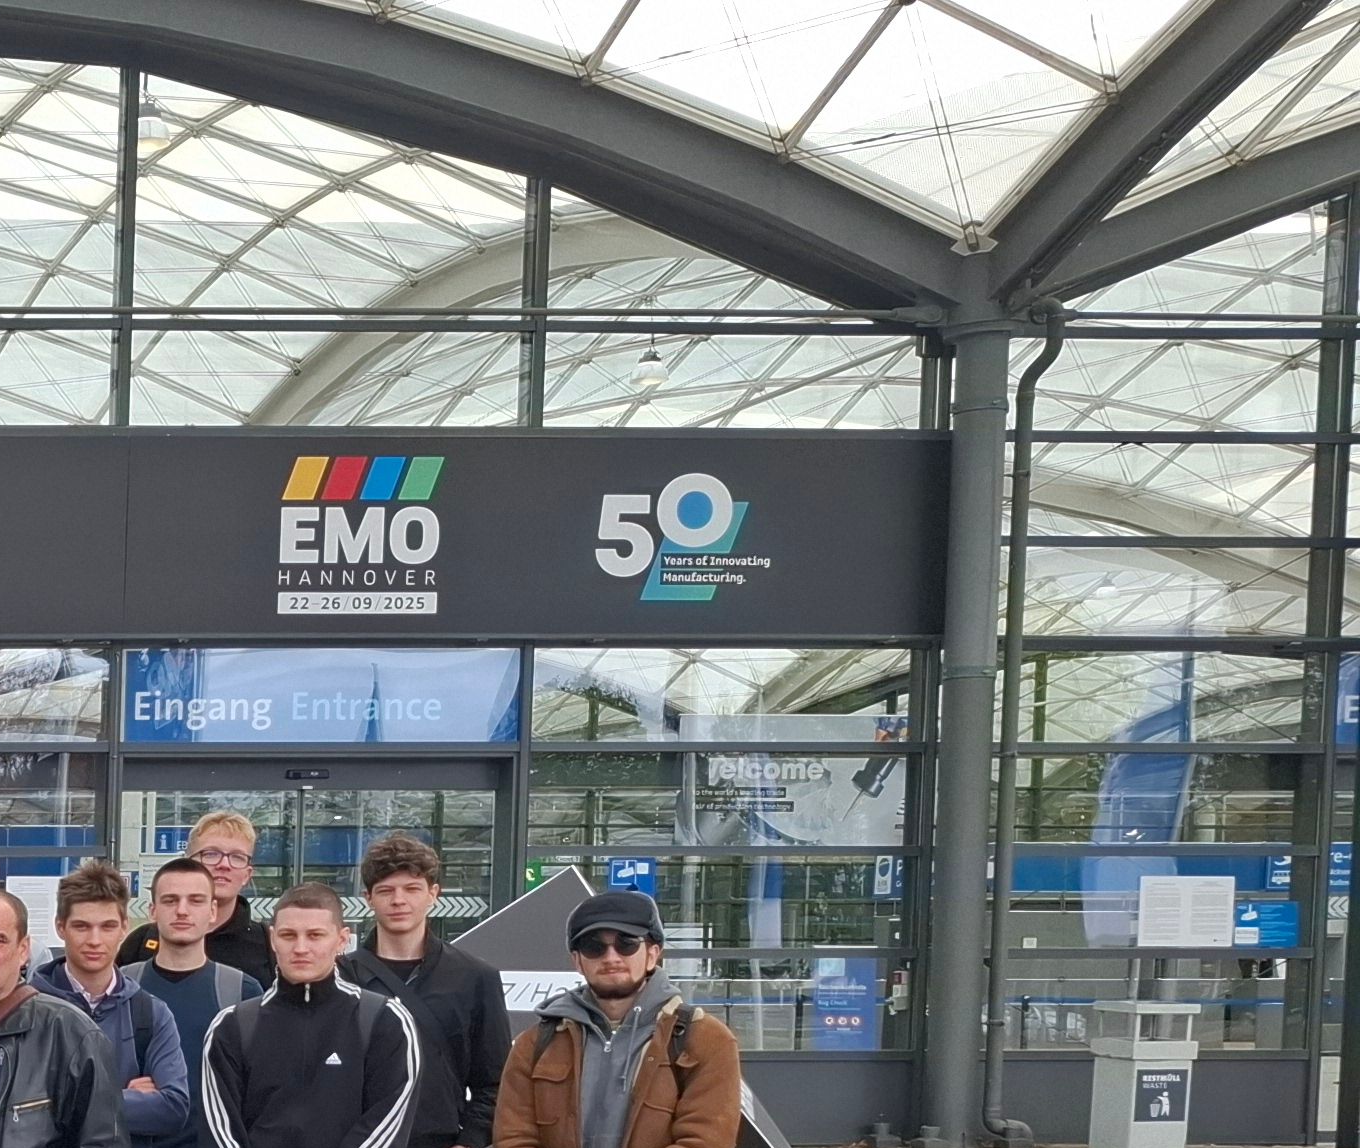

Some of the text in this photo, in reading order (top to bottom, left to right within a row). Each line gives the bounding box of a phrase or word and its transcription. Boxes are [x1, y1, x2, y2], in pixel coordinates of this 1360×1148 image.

[279, 506, 440, 565] EMO
[595, 473, 733, 577] 50
[663, 556, 771, 568] Years of Innovating
[278, 570, 436, 586] HANNOVER
[663, 572, 747, 584] Manufacturing.
[133, 690, 442, 731] Eingang Entrance
